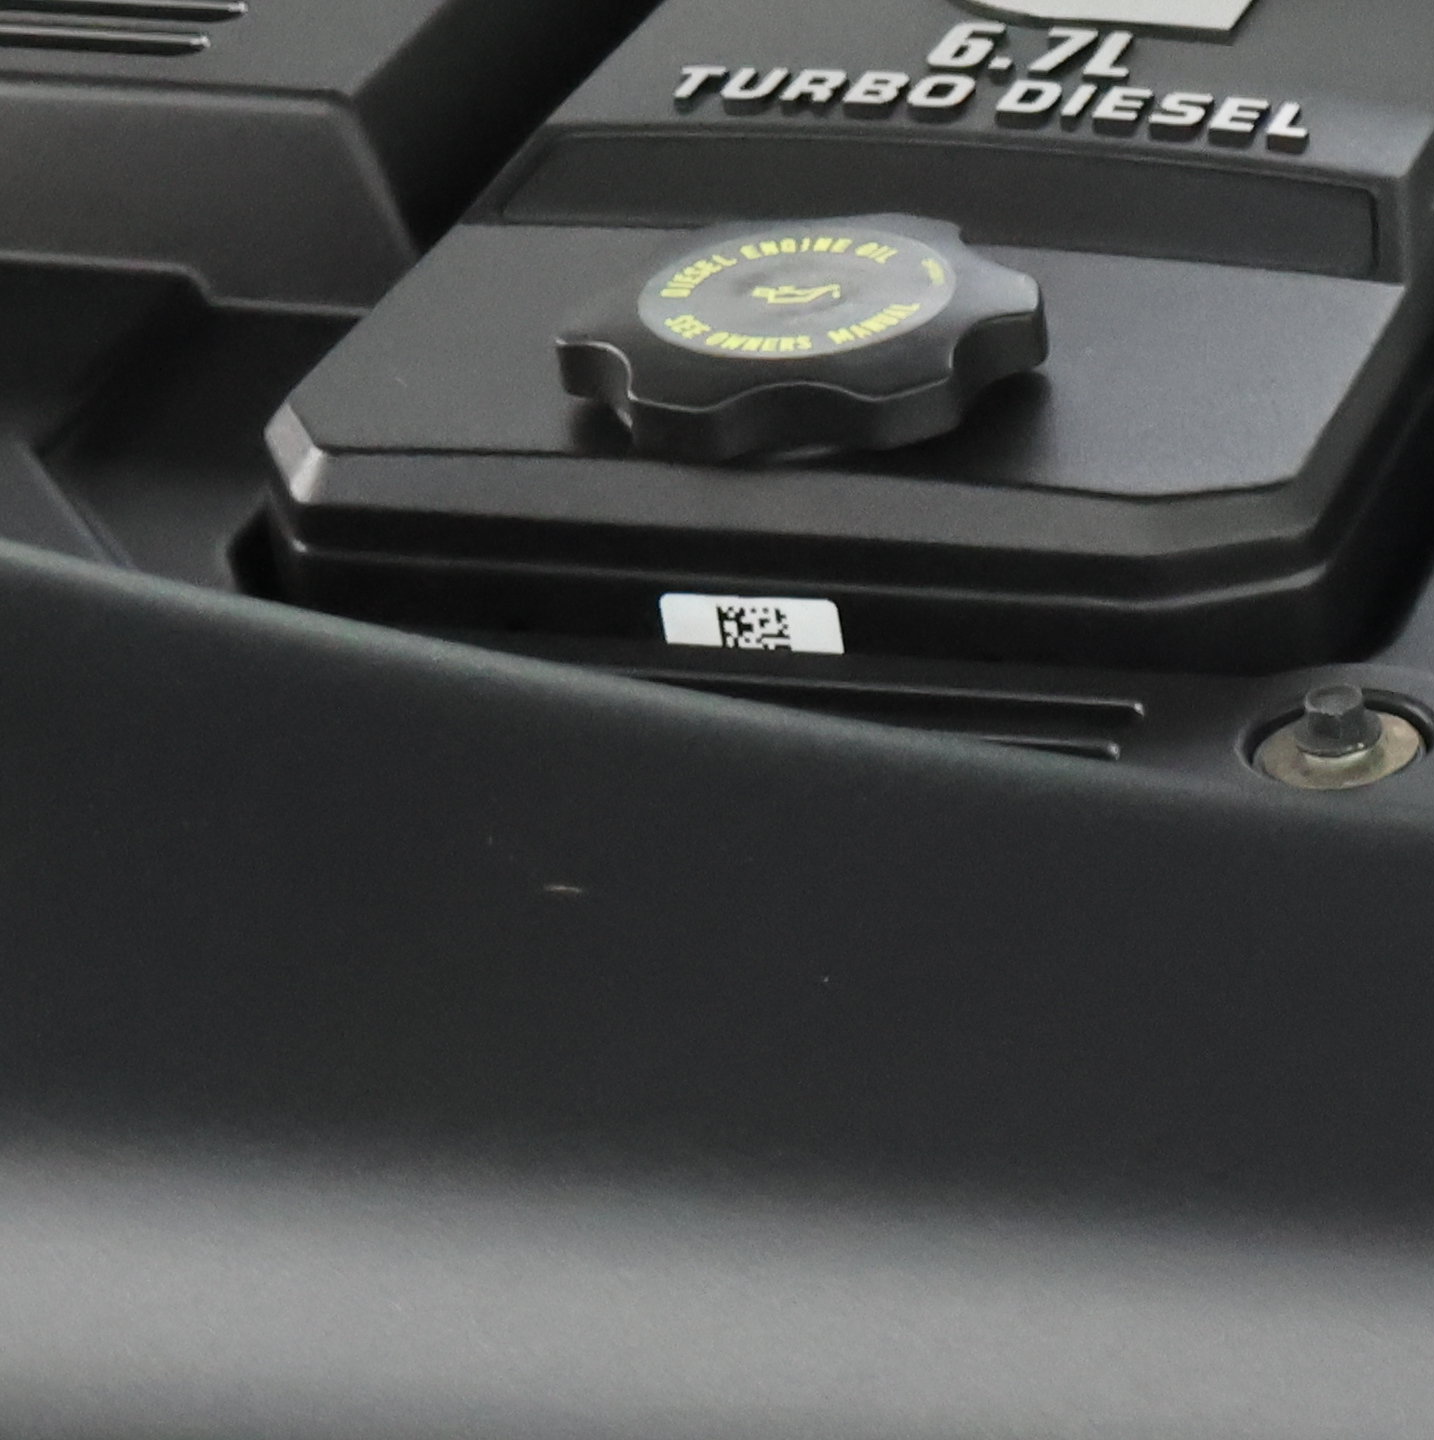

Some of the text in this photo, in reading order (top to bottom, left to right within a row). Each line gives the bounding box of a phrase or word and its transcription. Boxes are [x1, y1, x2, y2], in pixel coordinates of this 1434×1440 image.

[925, 20, 1135, 82] 6.7L
[673, 64, 1310, 148] TURBO DIESEL
[659, 237, 899, 298] DIESEL ENGINE OIL
[664, 301, 922, 352] SEE OWNERS MANUAL
